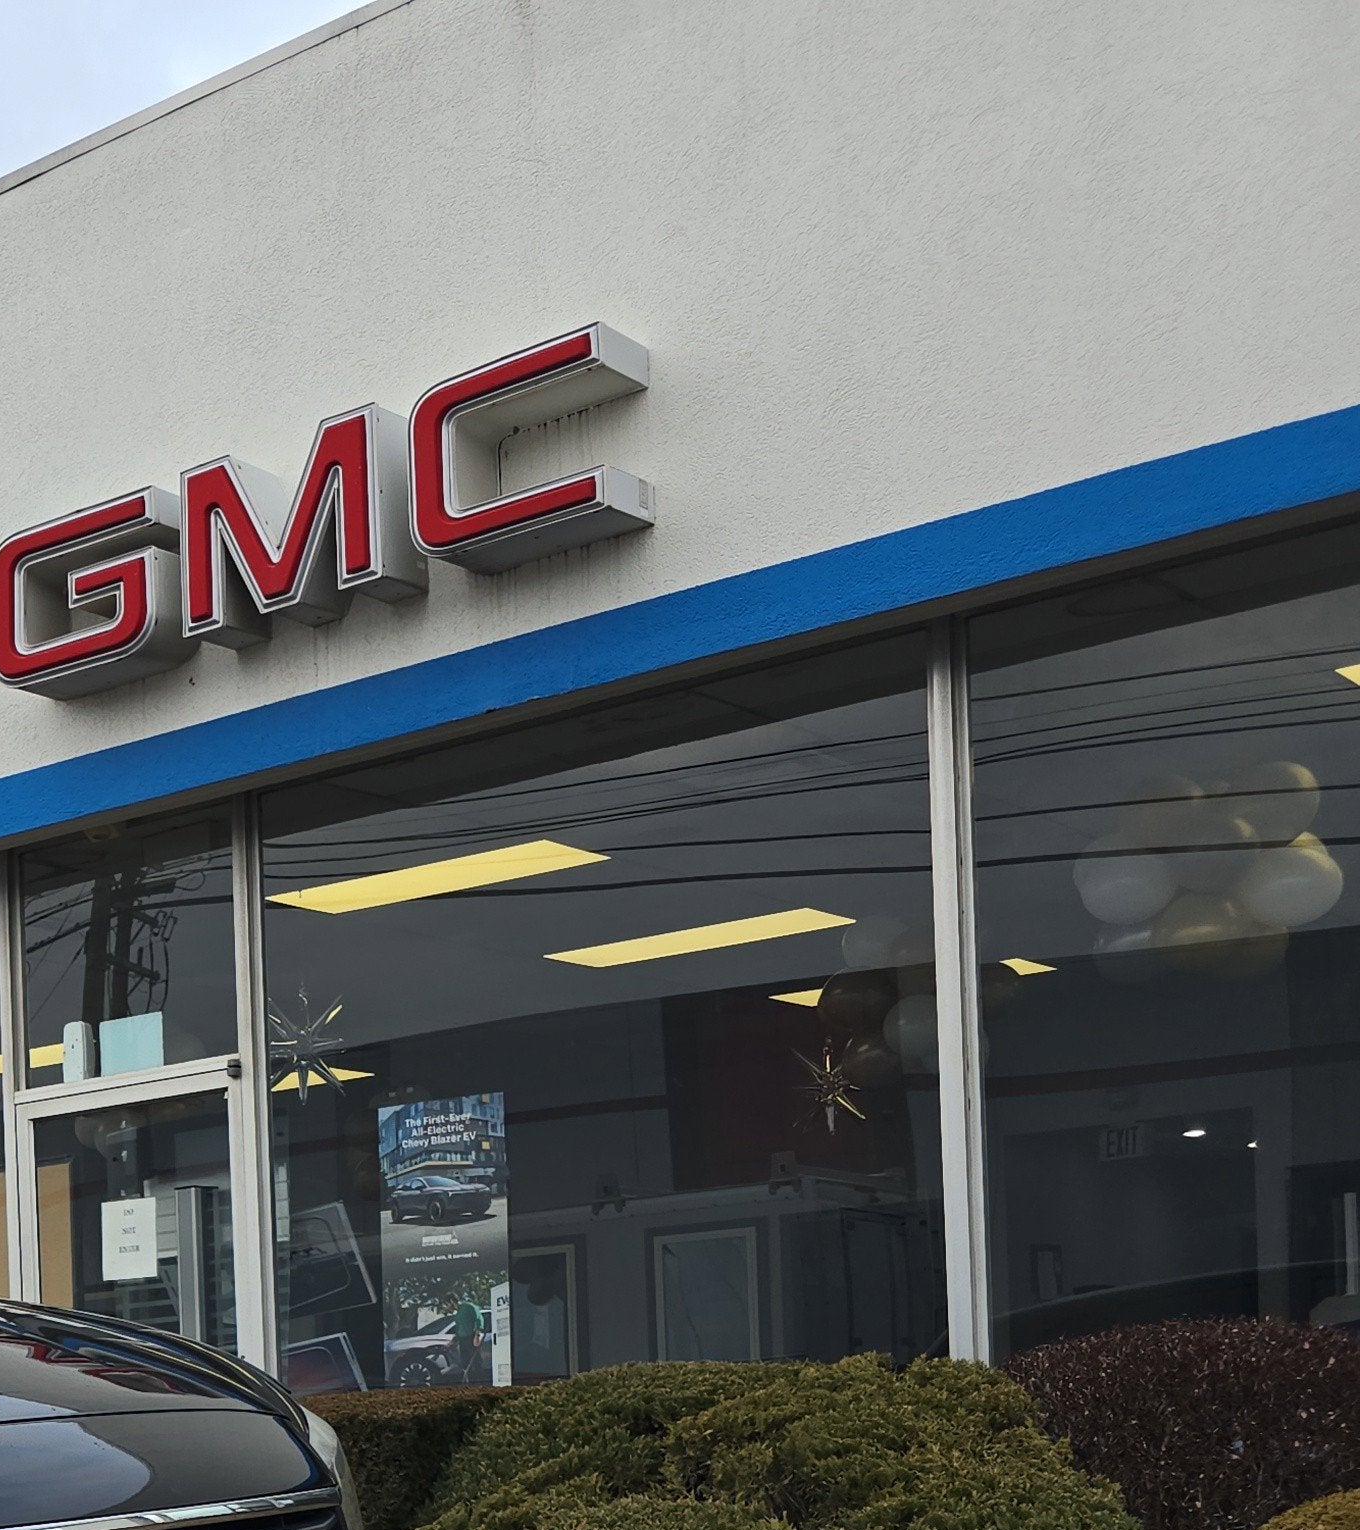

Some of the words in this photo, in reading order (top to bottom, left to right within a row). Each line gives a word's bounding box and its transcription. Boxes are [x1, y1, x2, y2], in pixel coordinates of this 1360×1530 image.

[405, 1118, 422, 1127] The
[423, 1112, 472, 1125] First-Ever
[411, 1123, 465, 1137] All-Electric
[402, 1138, 429, 1148] Chevy
[430, 1135, 462, 1145] Blazer
[463, 1130, 477, 1141] EV
[1107, 1126, 1138, 1157] EXIT
